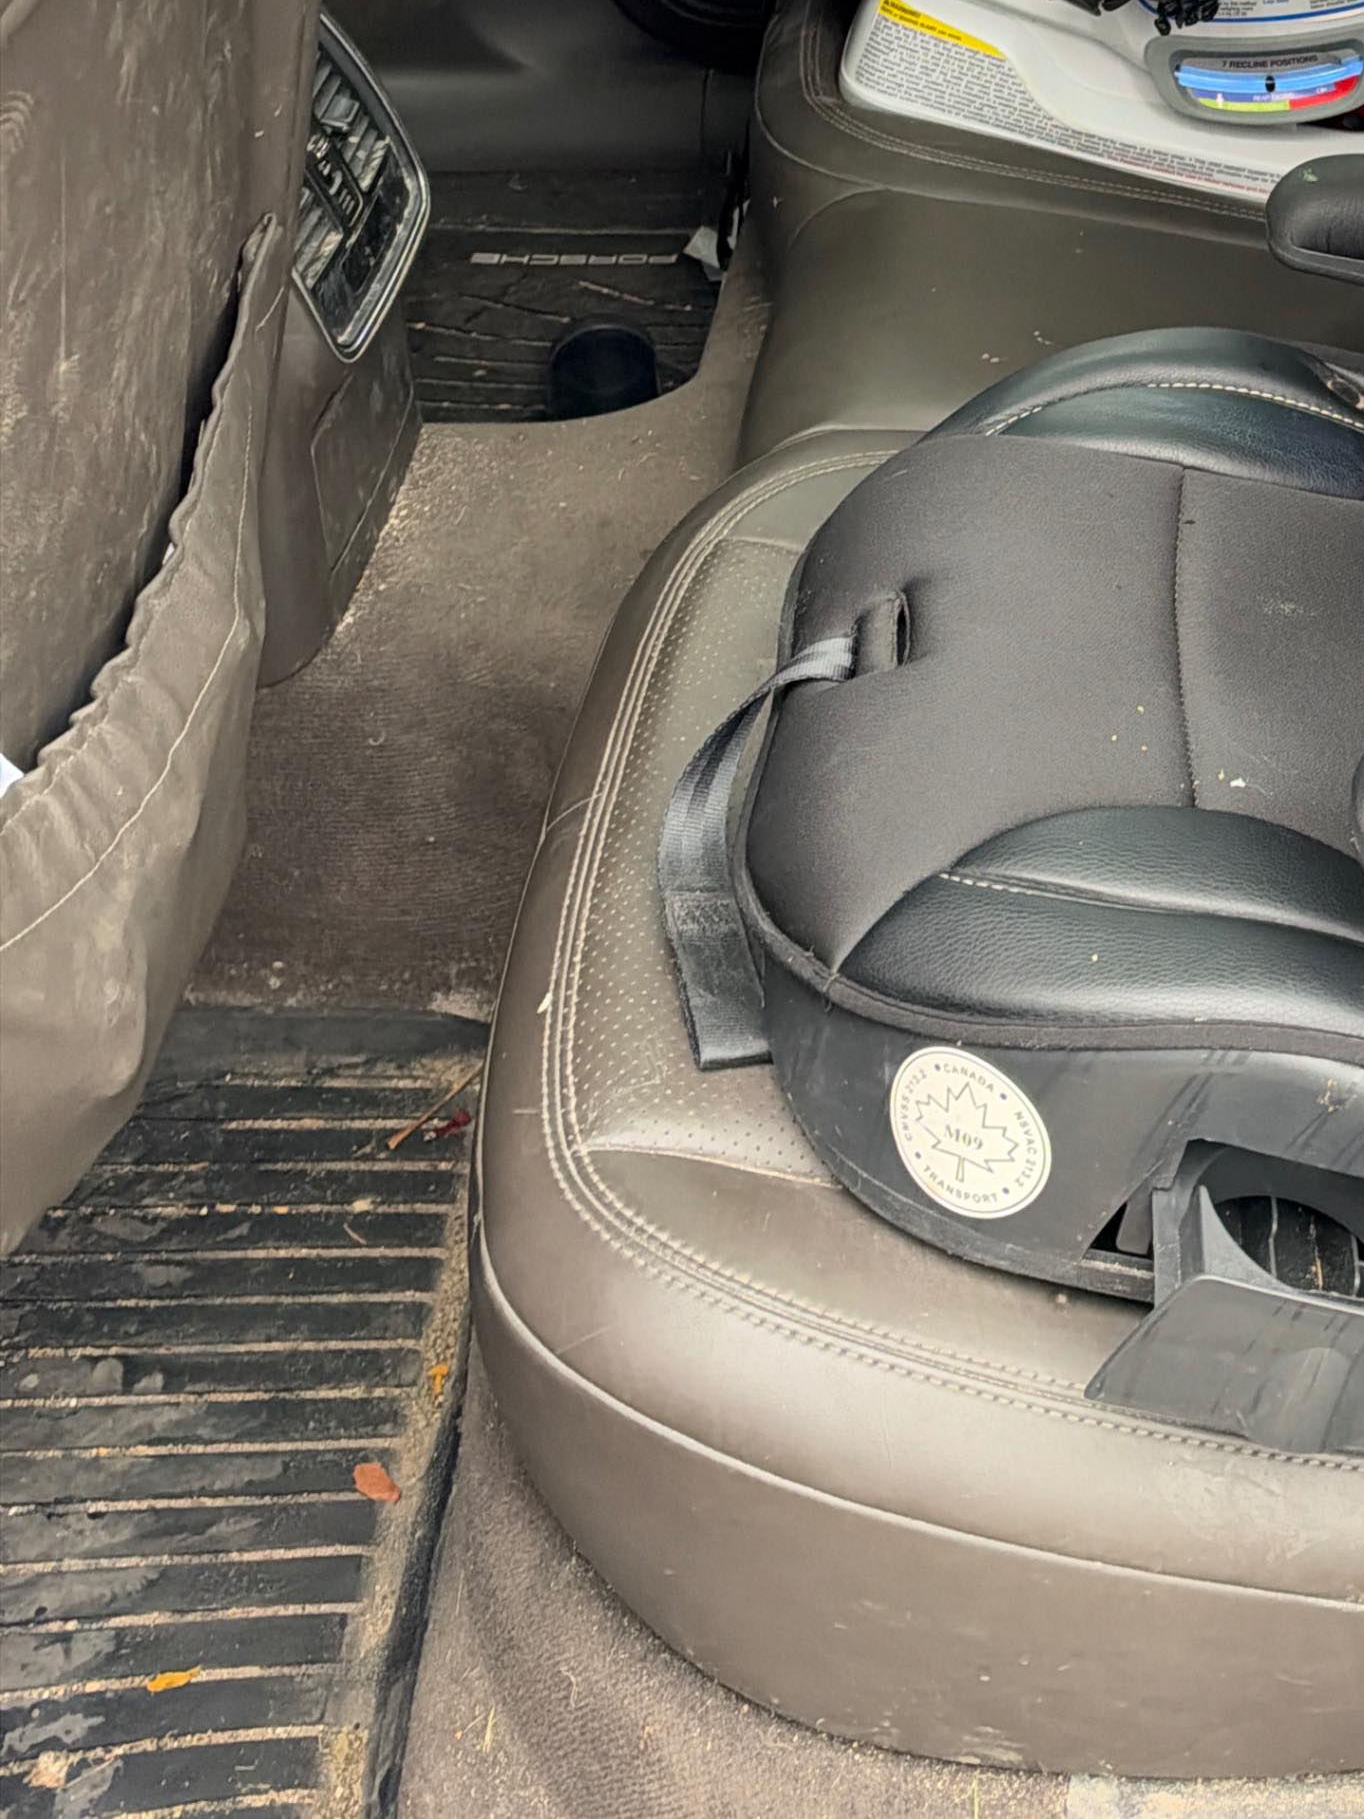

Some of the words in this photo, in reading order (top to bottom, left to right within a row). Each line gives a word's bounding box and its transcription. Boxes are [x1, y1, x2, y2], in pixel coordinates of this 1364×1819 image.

[1229, 60, 1268, 69] RECLINE
[1270, 54, 1318, 67] POSITIONS
[470, 252, 679, 266] PORSCHE
[943, 1063, 995, 1094] CANADA
[945, 1124, 984, 1151] M09
[923, 1164, 998, 1204] TRANSPORT
